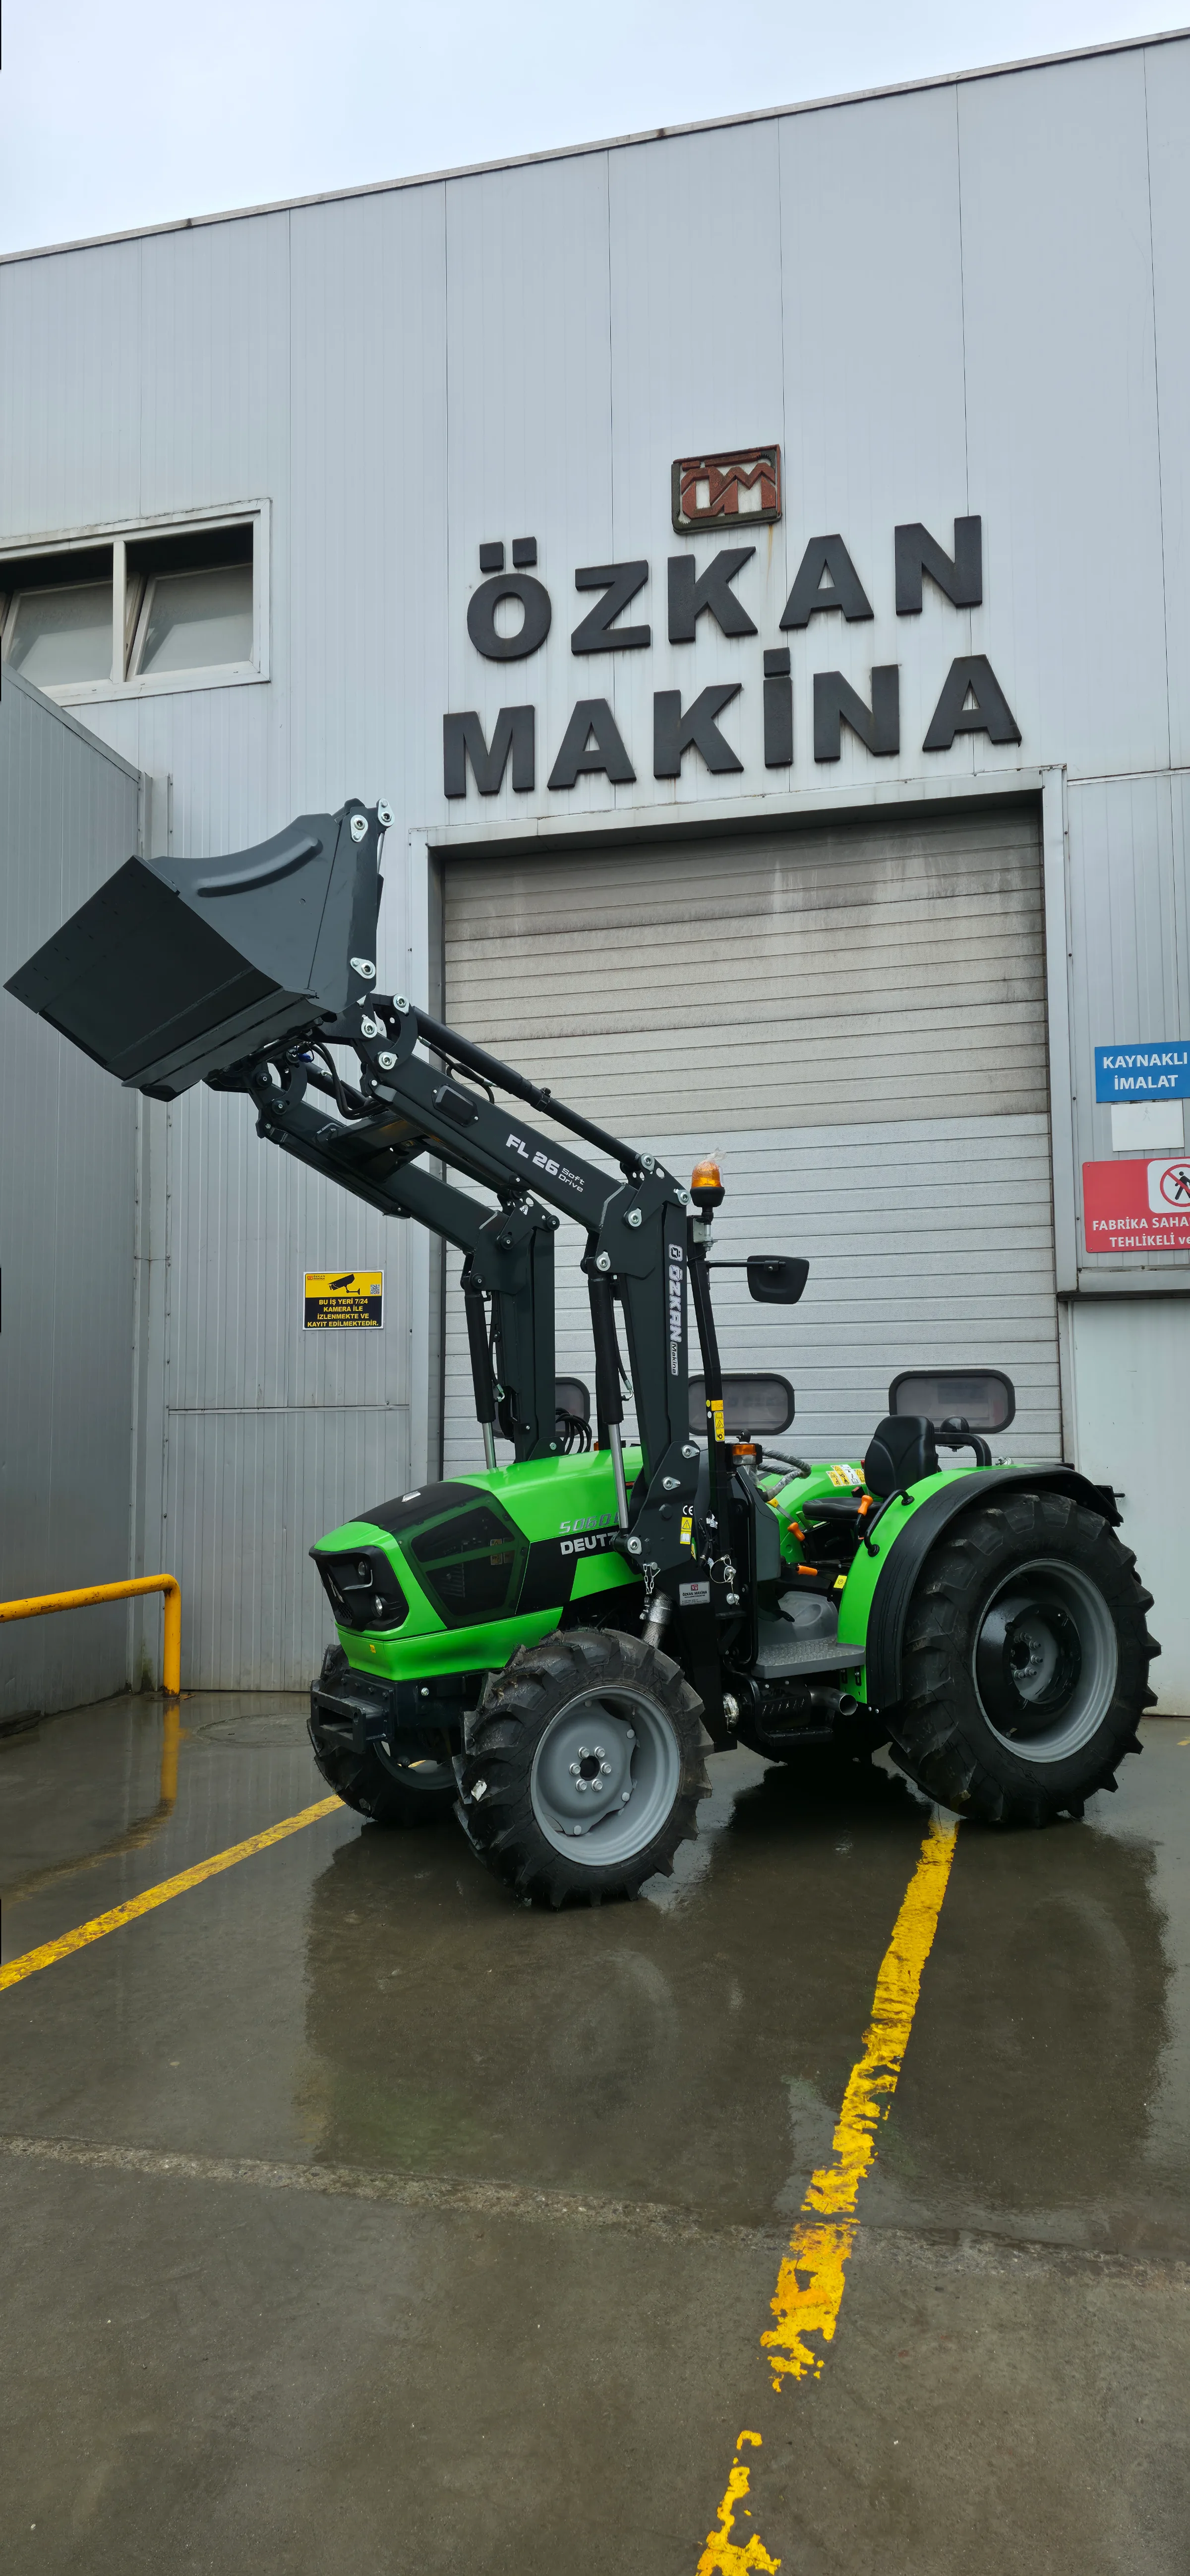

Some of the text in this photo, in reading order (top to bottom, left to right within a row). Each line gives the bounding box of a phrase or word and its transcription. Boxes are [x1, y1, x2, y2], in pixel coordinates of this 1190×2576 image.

[467, 515, 983, 661] ÖZKAN
[443, 647, 1022, 798] MAKİNA
[1103, 1052, 1188, 1069] KAYNAKLI
[1114, 1075, 1179, 1090] İMALAT
[506, 1134, 560, 1176] FL 26
[558, 1174, 584, 1193] Drive
[562, 1167, 585, 1185] Soft
[1093, 1216, 1190, 1231] FABRİKA SAHA
[1109, 1232, 1175, 1248] TEHLİKELİ
[330, 1298, 336, 1306] İŞ
[669, 1264, 683, 1342] ÖZKAN
[683, 1505, 694, 1516] CE
